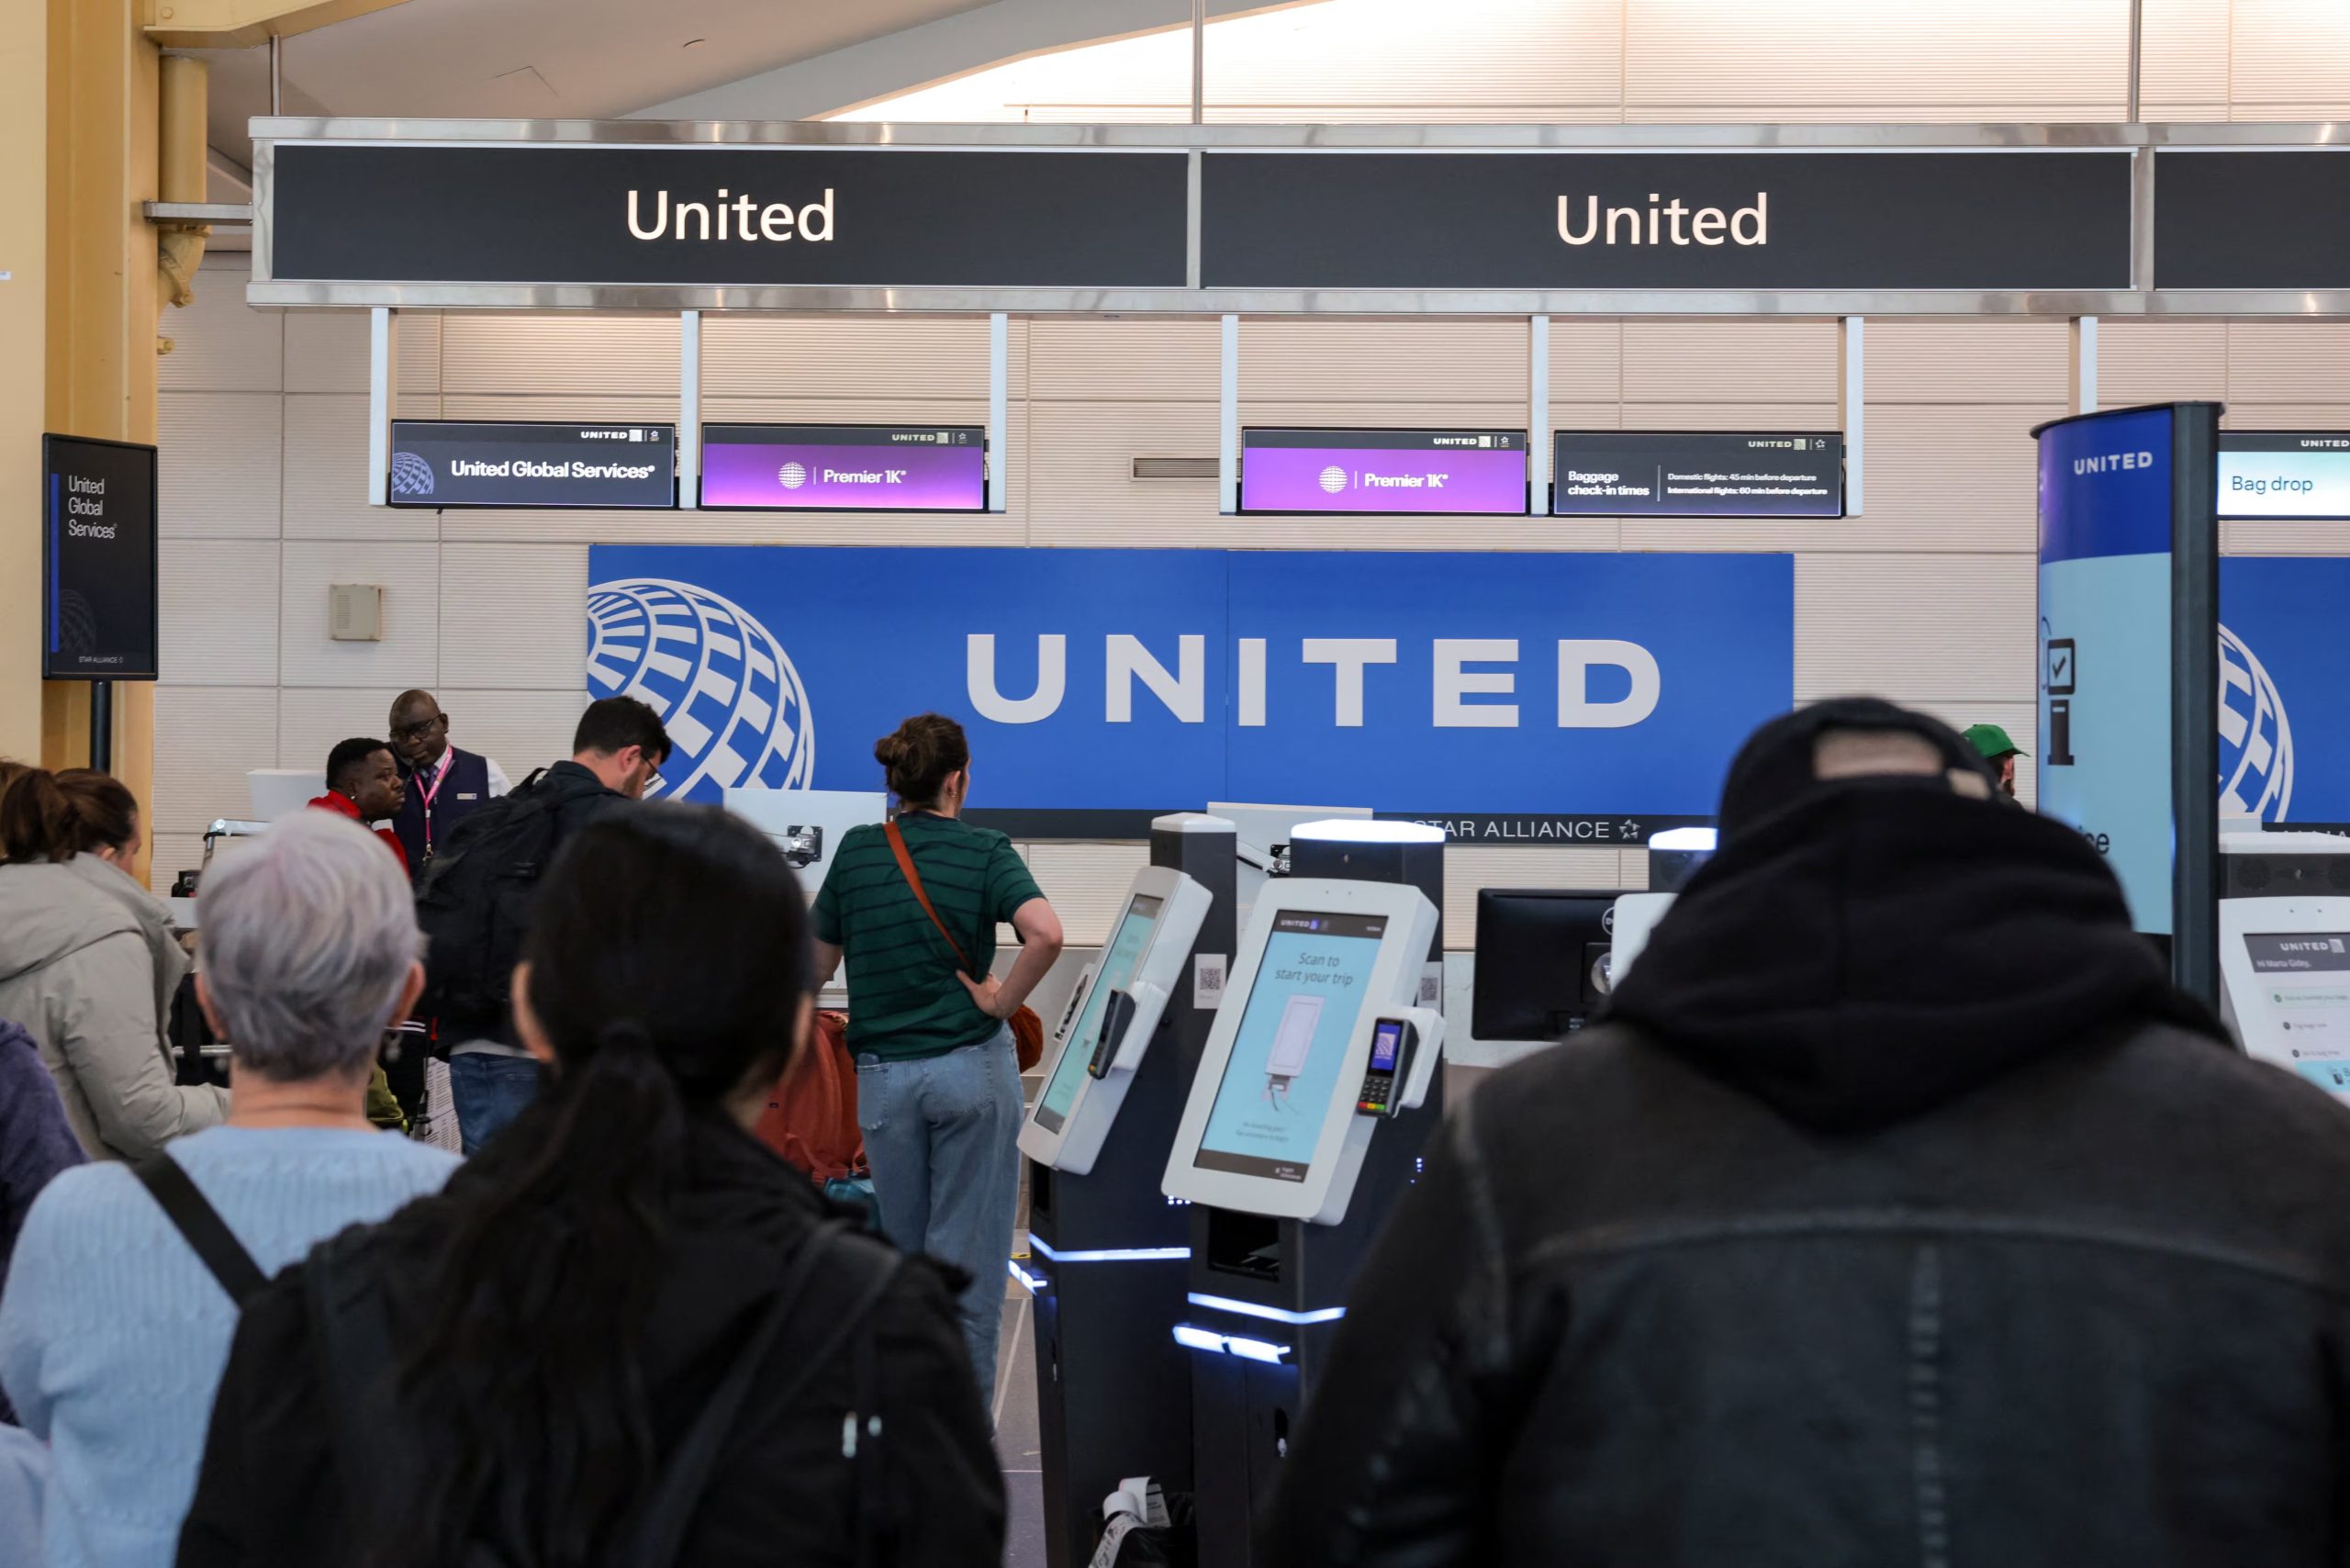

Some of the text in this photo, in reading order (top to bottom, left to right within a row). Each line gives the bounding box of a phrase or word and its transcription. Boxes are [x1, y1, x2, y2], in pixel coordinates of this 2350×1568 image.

[628, 188, 834, 241] United
[1558, 192, 1767, 246] United
[580, 431, 628, 440] UNITED
[891, 434, 935, 442] UNITED
[1433, 437, 1477, 446] UNITED
[451, 460, 509, 477] United
[511, 461, 569, 478] Global
[2074, 451, 2154, 476] UNITED
[823, 469, 882, 484] Premier
[1364, 473, 1425, 487] Premier
[1568, 470, 1619, 484] Baggage
[1667, 473, 1704, 481] Domestic
[1704, 473, 1729, 482] flights:
[1780, 474, 1817, 483] departure
[68, 475, 105, 495] United
[1568, 485, 1651, 496] check-in times
[1667, 487, 1714, 495] International
[1714, 487, 1739, 496] flights:
[1739, 487, 1751, 495] 60
[2232, 476, 2313, 495] Bag drop
[68, 497, 104, 516] Global
[967, 633, 1661, 729] UNITED
[1484, 821, 1610, 838] ALLIANCE
[1281, 919, 1311, 928] UNITED
[2279, 942, 2329, 951] UNITED
[1298, 952, 1340, 968] Scan to
[1274, 969, 1354, 988] start your trip
